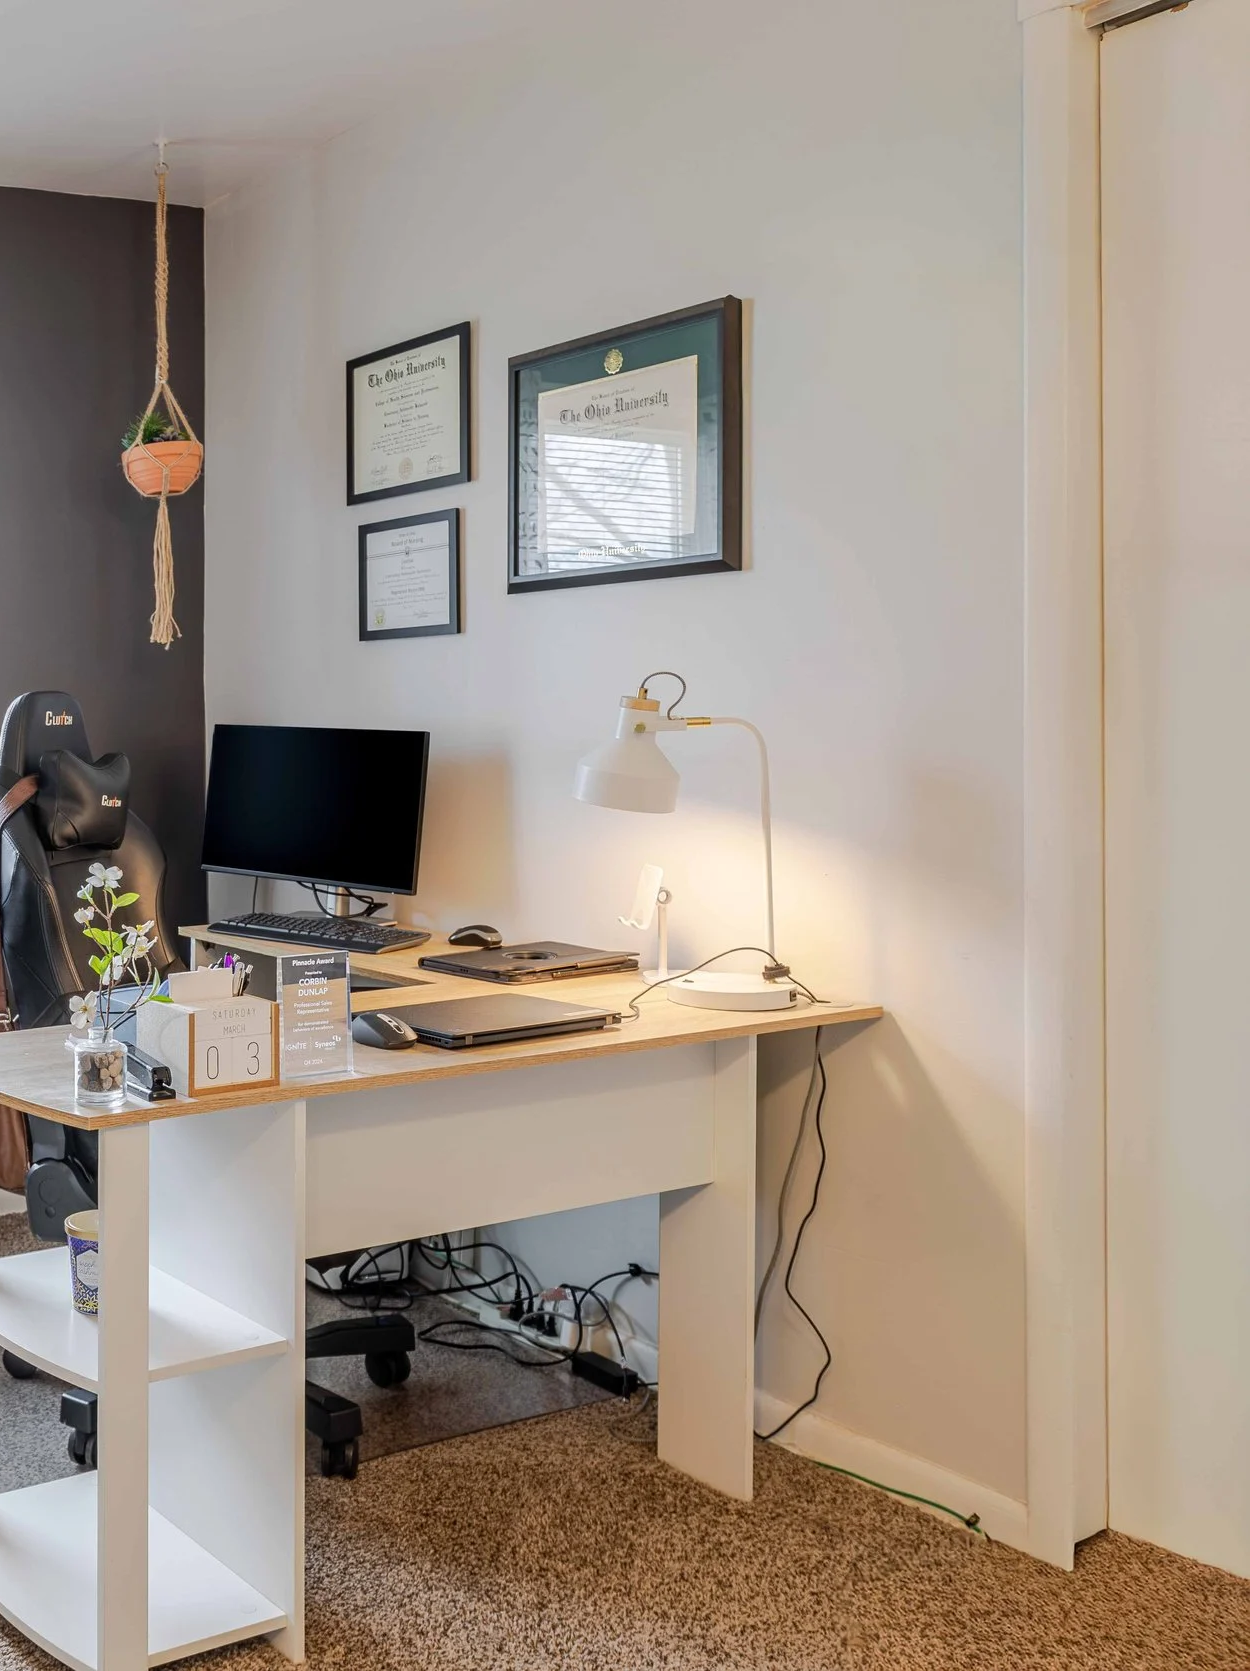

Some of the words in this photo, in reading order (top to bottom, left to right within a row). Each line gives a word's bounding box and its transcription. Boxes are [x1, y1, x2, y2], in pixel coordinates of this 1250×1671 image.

[368, 374, 383, 388] The
[385, 369, 404, 383] Ohio
[406, 355, 446, 376] University
[560, 409, 581, 424] The
[585, 403, 610, 420] Ohio
[615, 389, 669, 413] University
[45, 710, 73, 727] CLUTCH
[101, 794, 122, 808] CLUTCH
[292, 958, 315, 967] Pinnacle
[316, 956, 334, 965] Award
[298, 976, 327, 987] CORBIN
[298, 987, 328, 997] DUNLAP
[212, 1008, 257, 1020] SATURDAY
[223, 1023, 246, 1036] MARCH
[314, 1041, 336, 1049] Syneos
[206, 1045, 220, 1080] 0
[246, 1041, 260, 1076] 3
